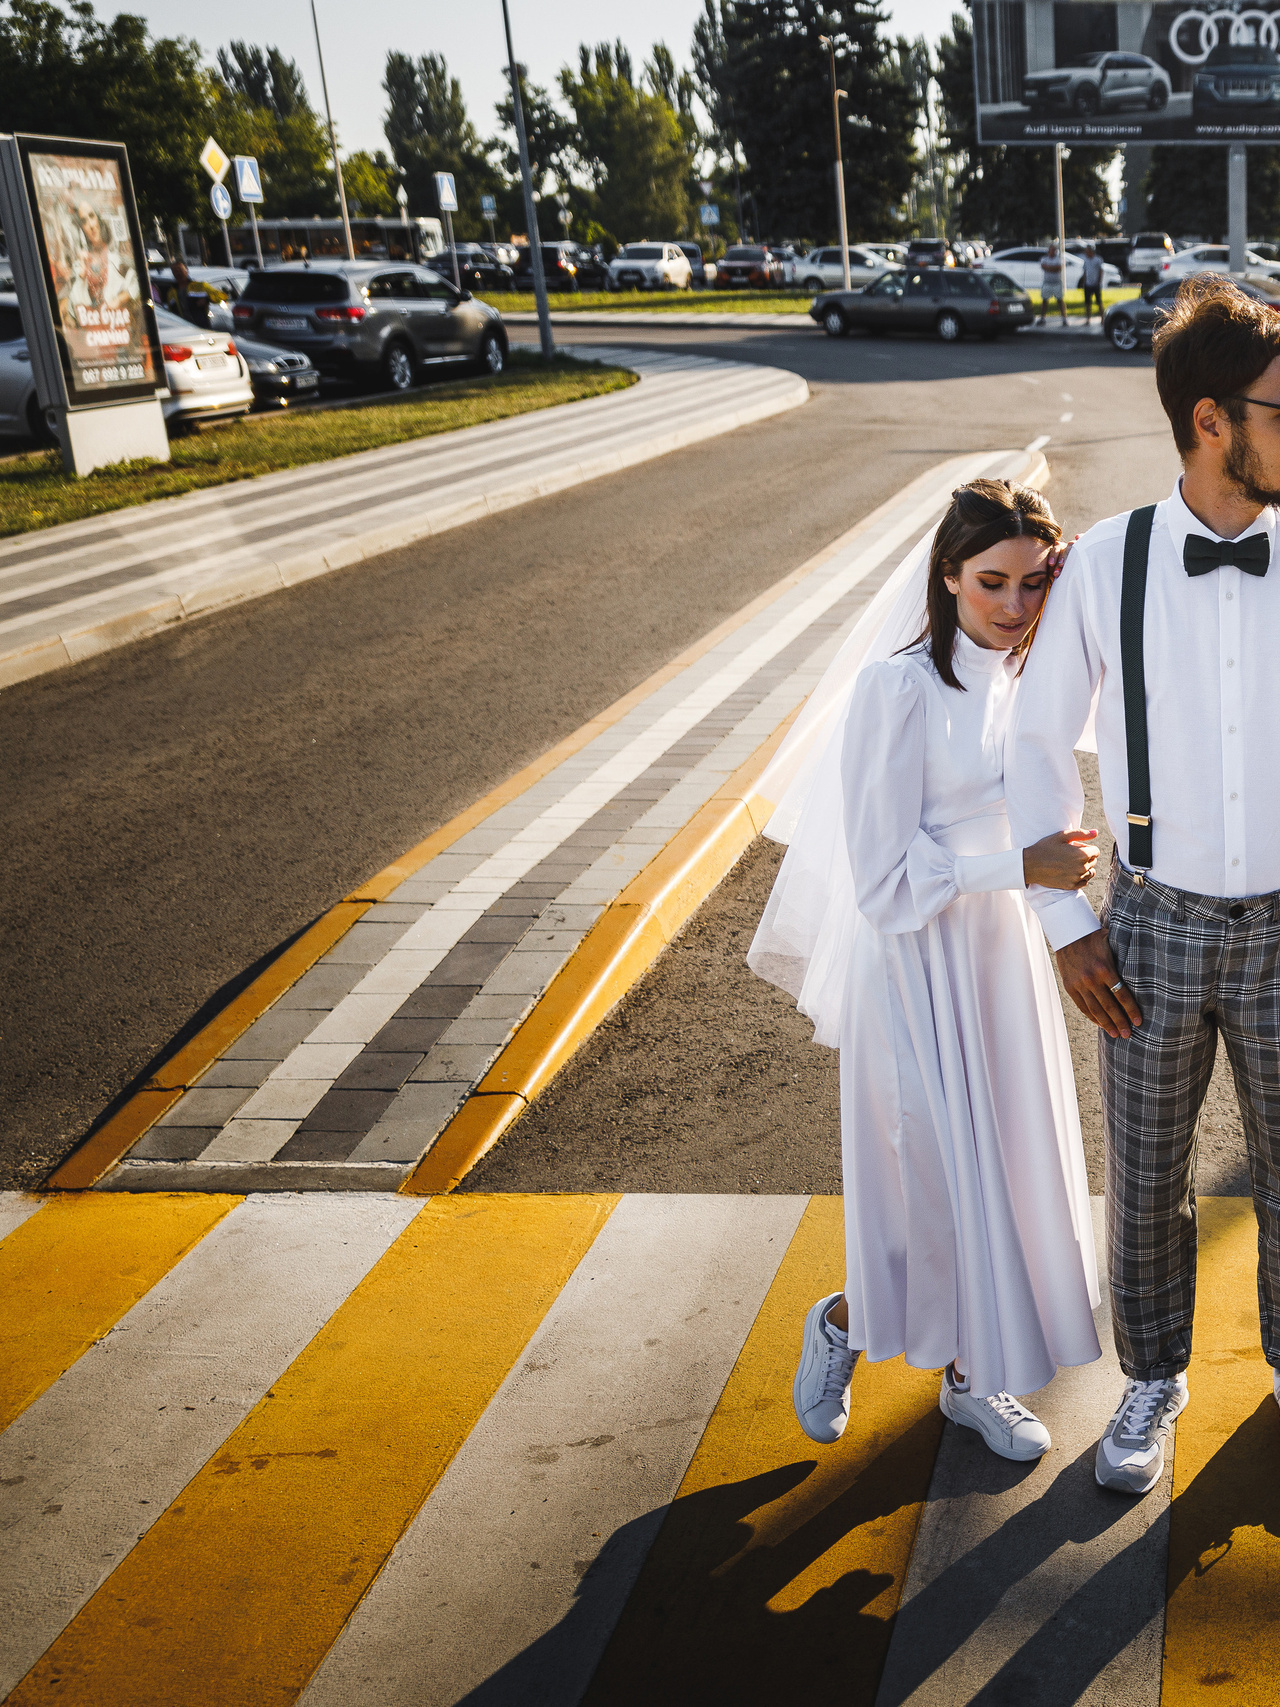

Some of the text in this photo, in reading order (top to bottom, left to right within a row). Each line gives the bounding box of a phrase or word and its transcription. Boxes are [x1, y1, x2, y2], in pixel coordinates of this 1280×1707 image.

[1024, 124, 1048, 135] Audi
[77, 303, 130, 329] Все буде
[128, 363, 144, 379] 222
